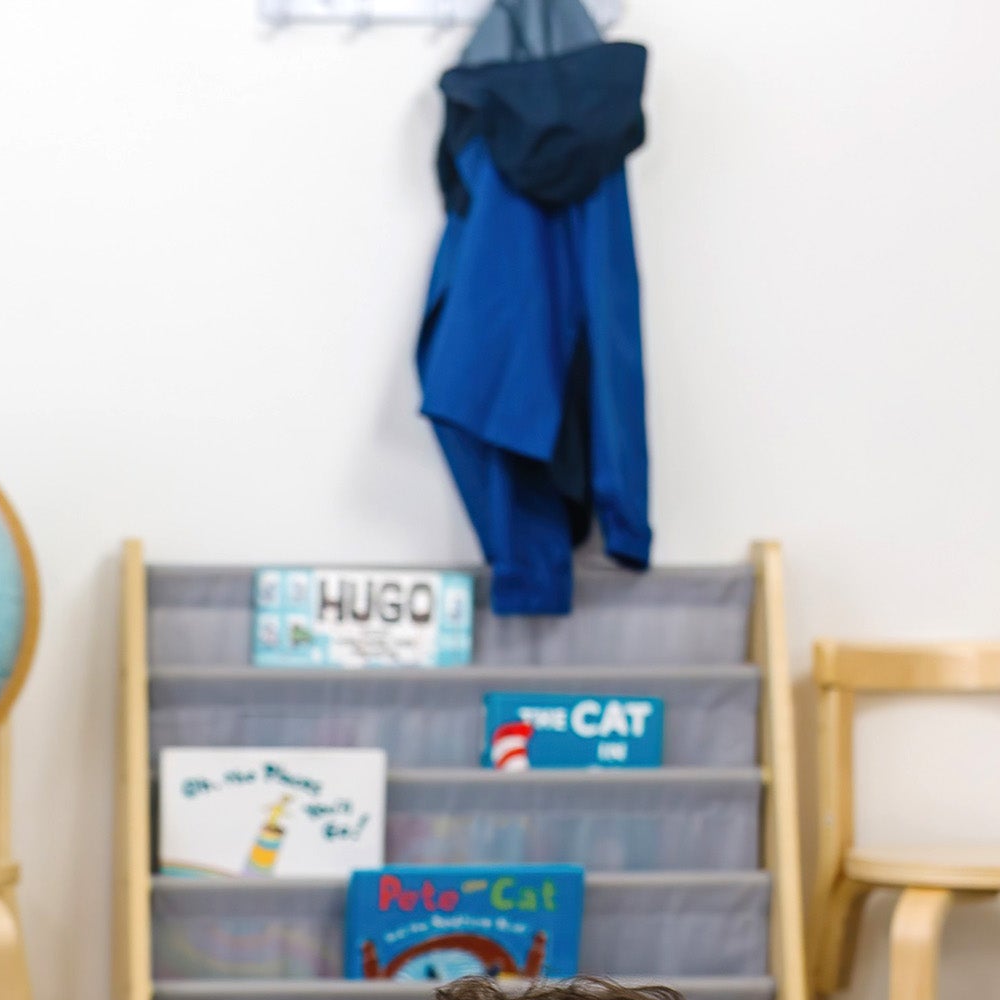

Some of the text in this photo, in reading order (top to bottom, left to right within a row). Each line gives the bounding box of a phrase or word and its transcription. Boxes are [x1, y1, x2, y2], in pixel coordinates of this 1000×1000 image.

[319, 579, 432, 623] HUGO
[518, 699, 653, 738] THE CAT
[597, 741, 628, 762] IN
[378, 874, 459, 911] Pete
[490, 876, 556, 912] Cat
